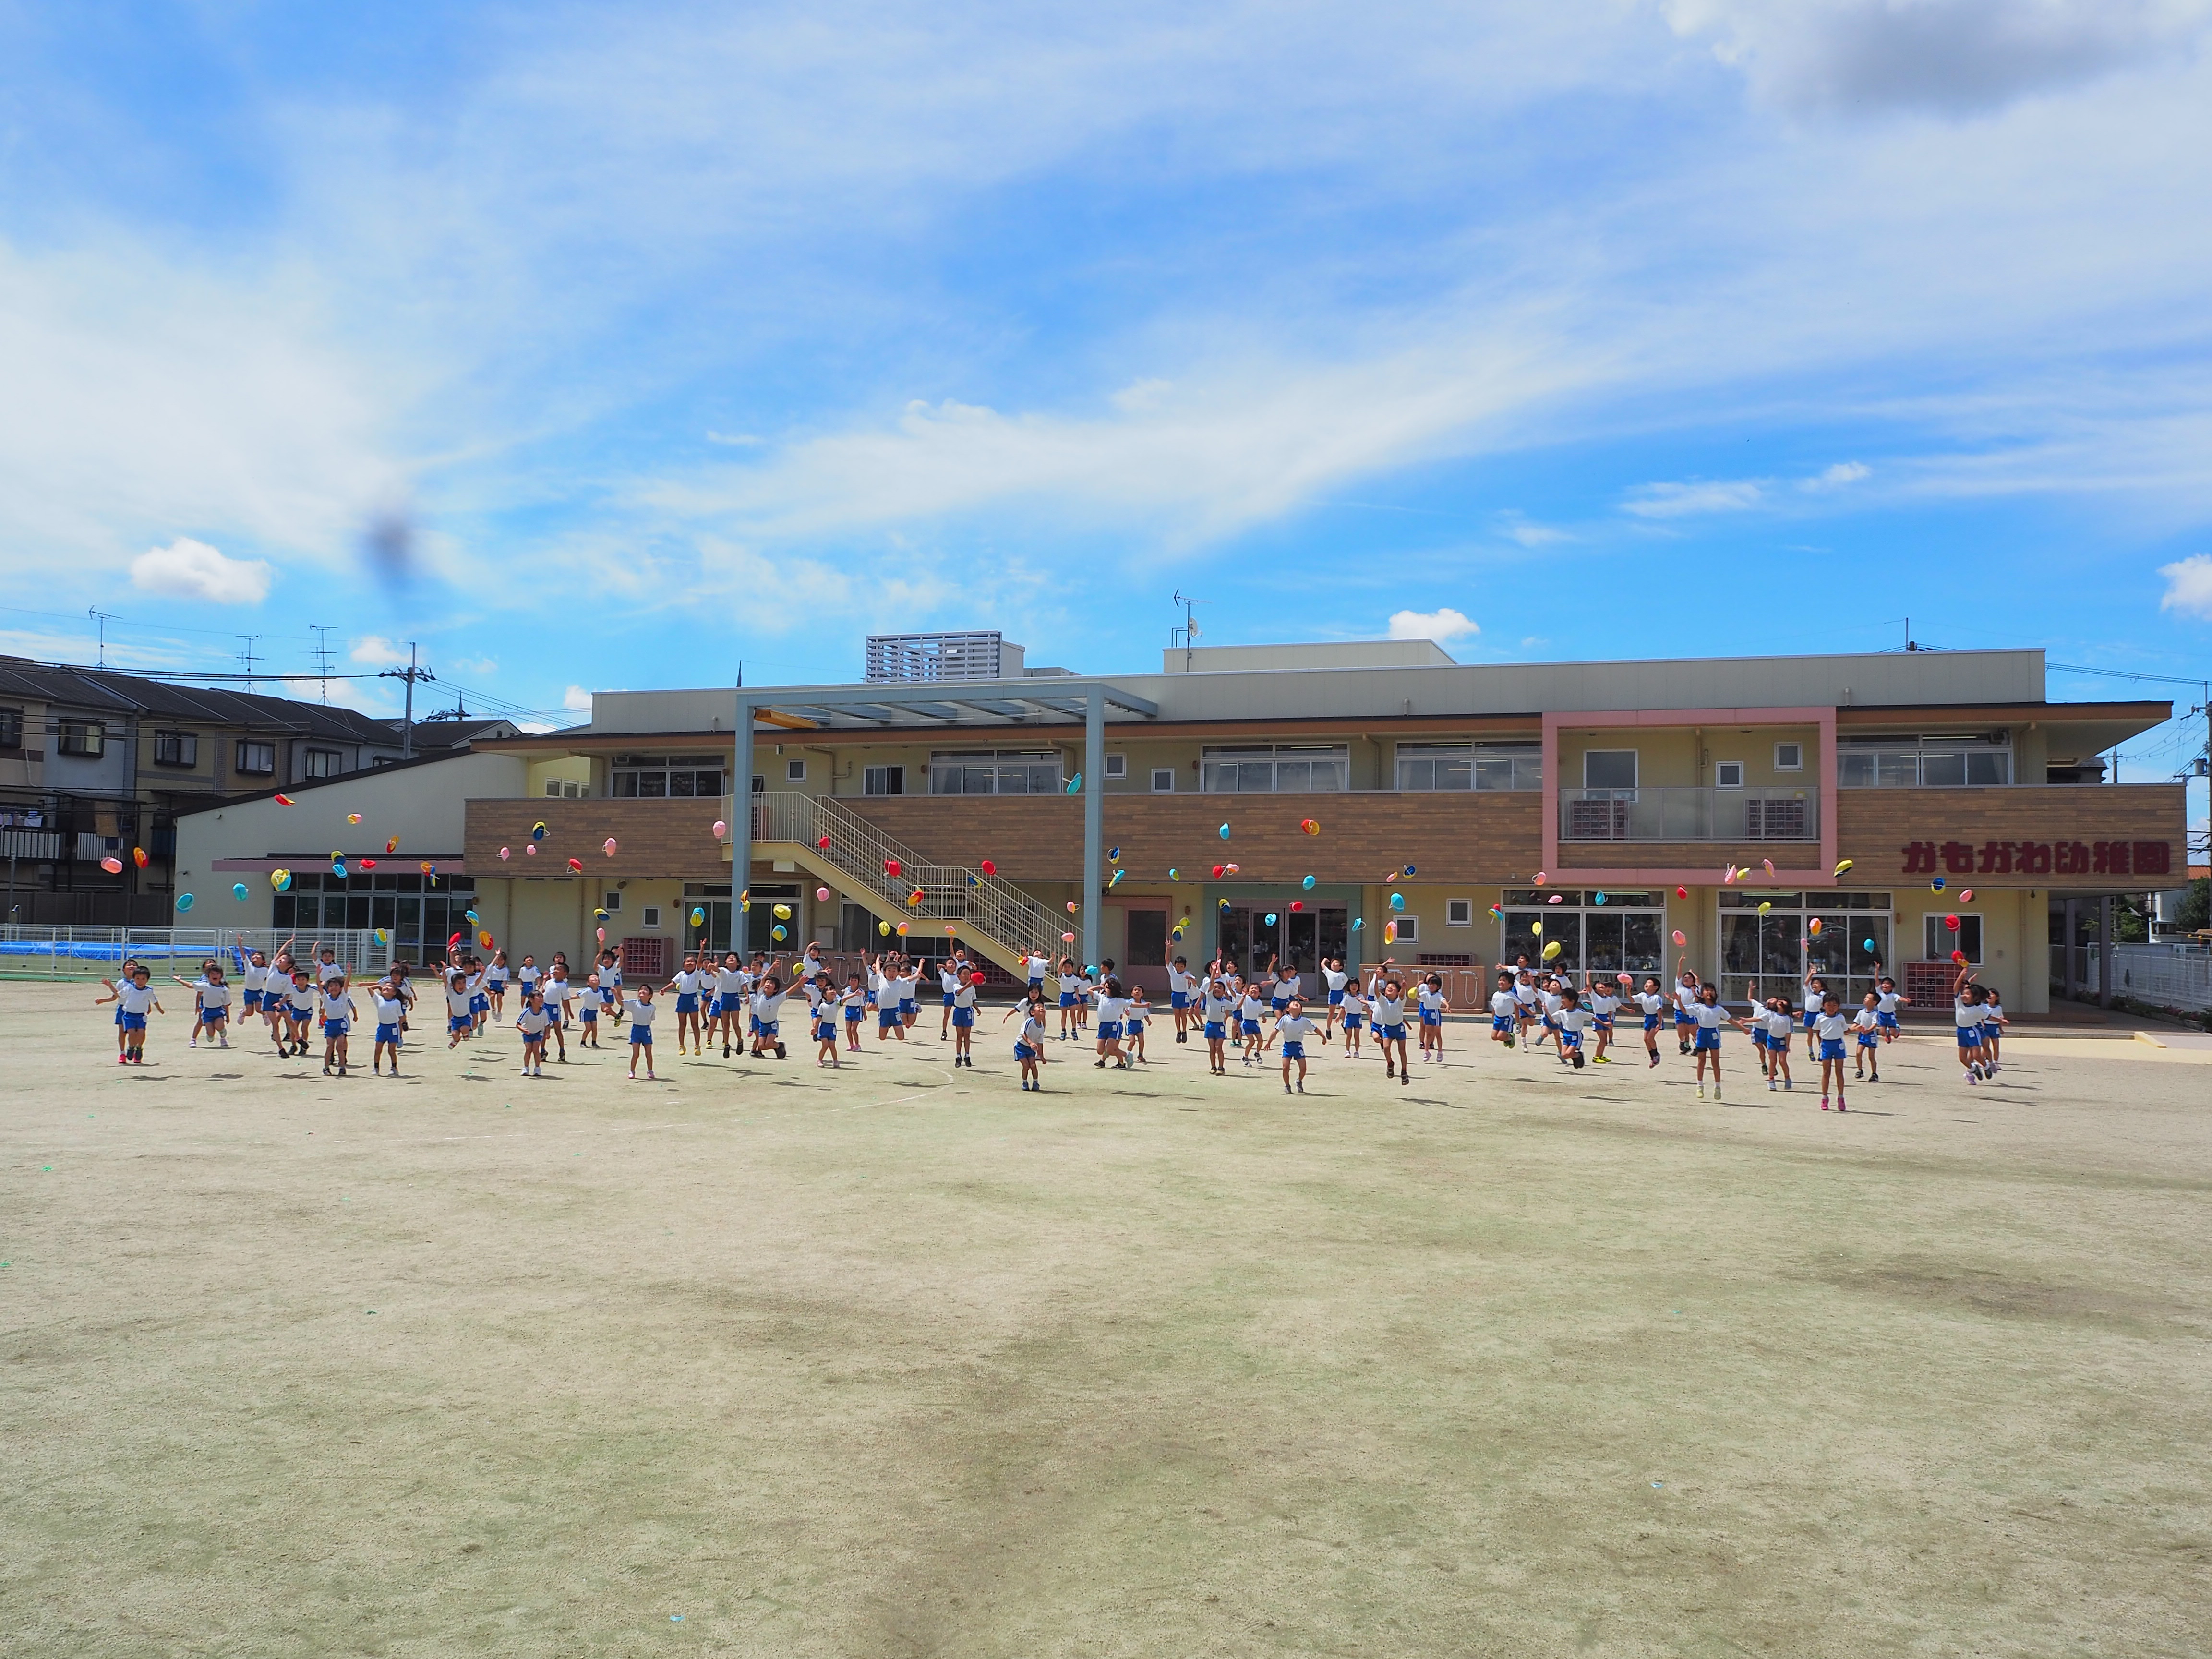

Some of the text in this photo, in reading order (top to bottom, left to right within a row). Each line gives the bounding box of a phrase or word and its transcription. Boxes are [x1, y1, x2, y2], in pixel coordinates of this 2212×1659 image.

[1902, 841, 2170, 874] かもがわ幼稚園
